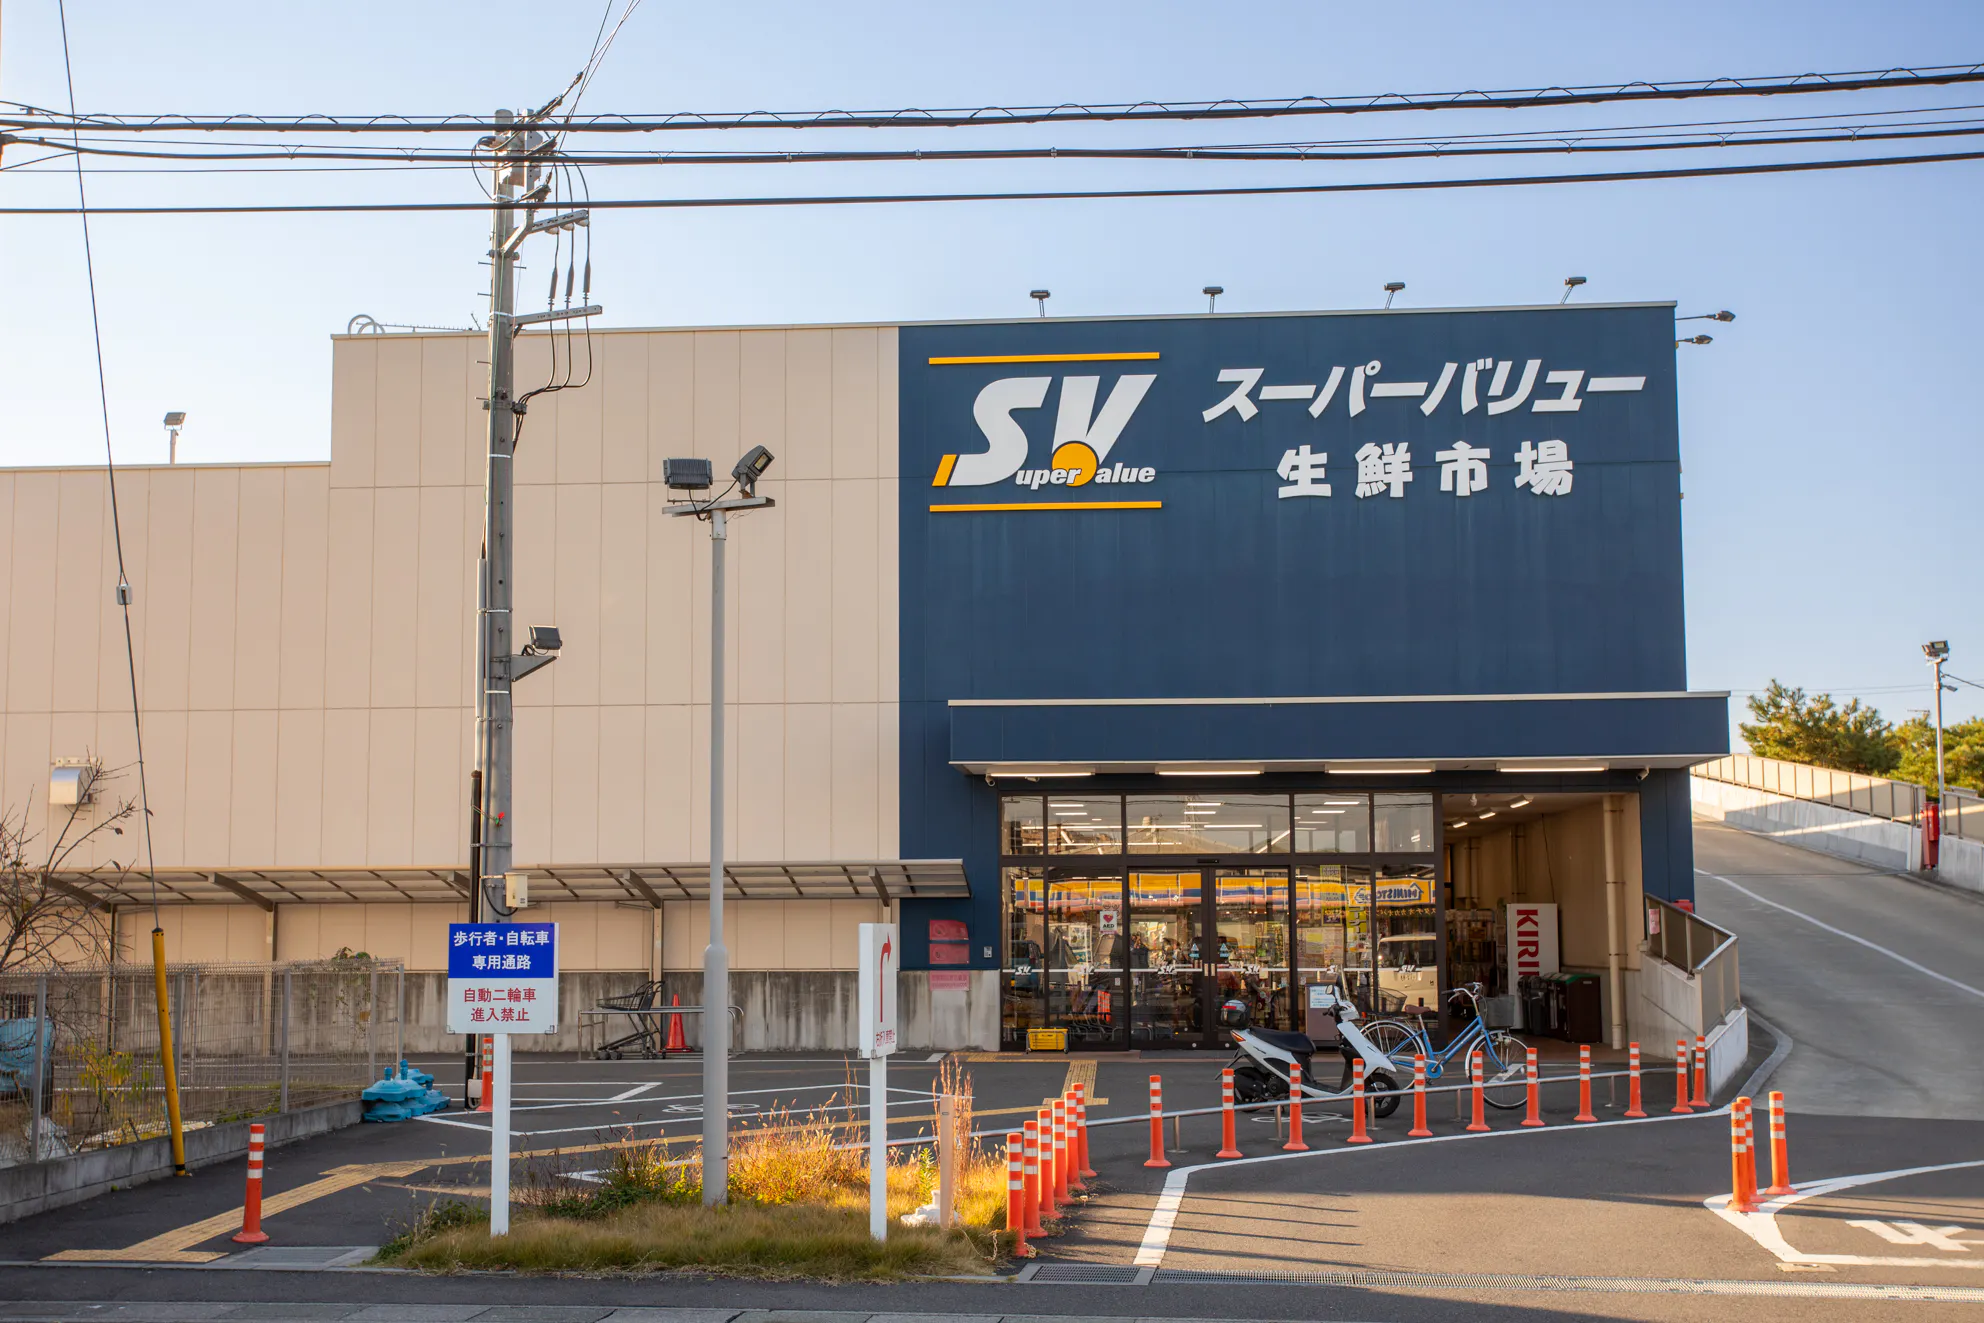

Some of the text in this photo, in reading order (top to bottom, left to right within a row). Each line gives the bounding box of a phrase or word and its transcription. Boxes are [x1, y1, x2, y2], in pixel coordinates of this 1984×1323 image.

[1202, 357, 1646, 422] スーパーバリュー
[1276, 440, 1573, 499] 生鮮市場
[453, 930, 550, 947] 歩行者・自転車
[1517, 909, 1540, 976] KIRI
[472, 954, 532, 970] 専用通路
[464, 987, 537, 1003] 自動二輪車
[470, 1007, 530, 1022] 進入禁止
